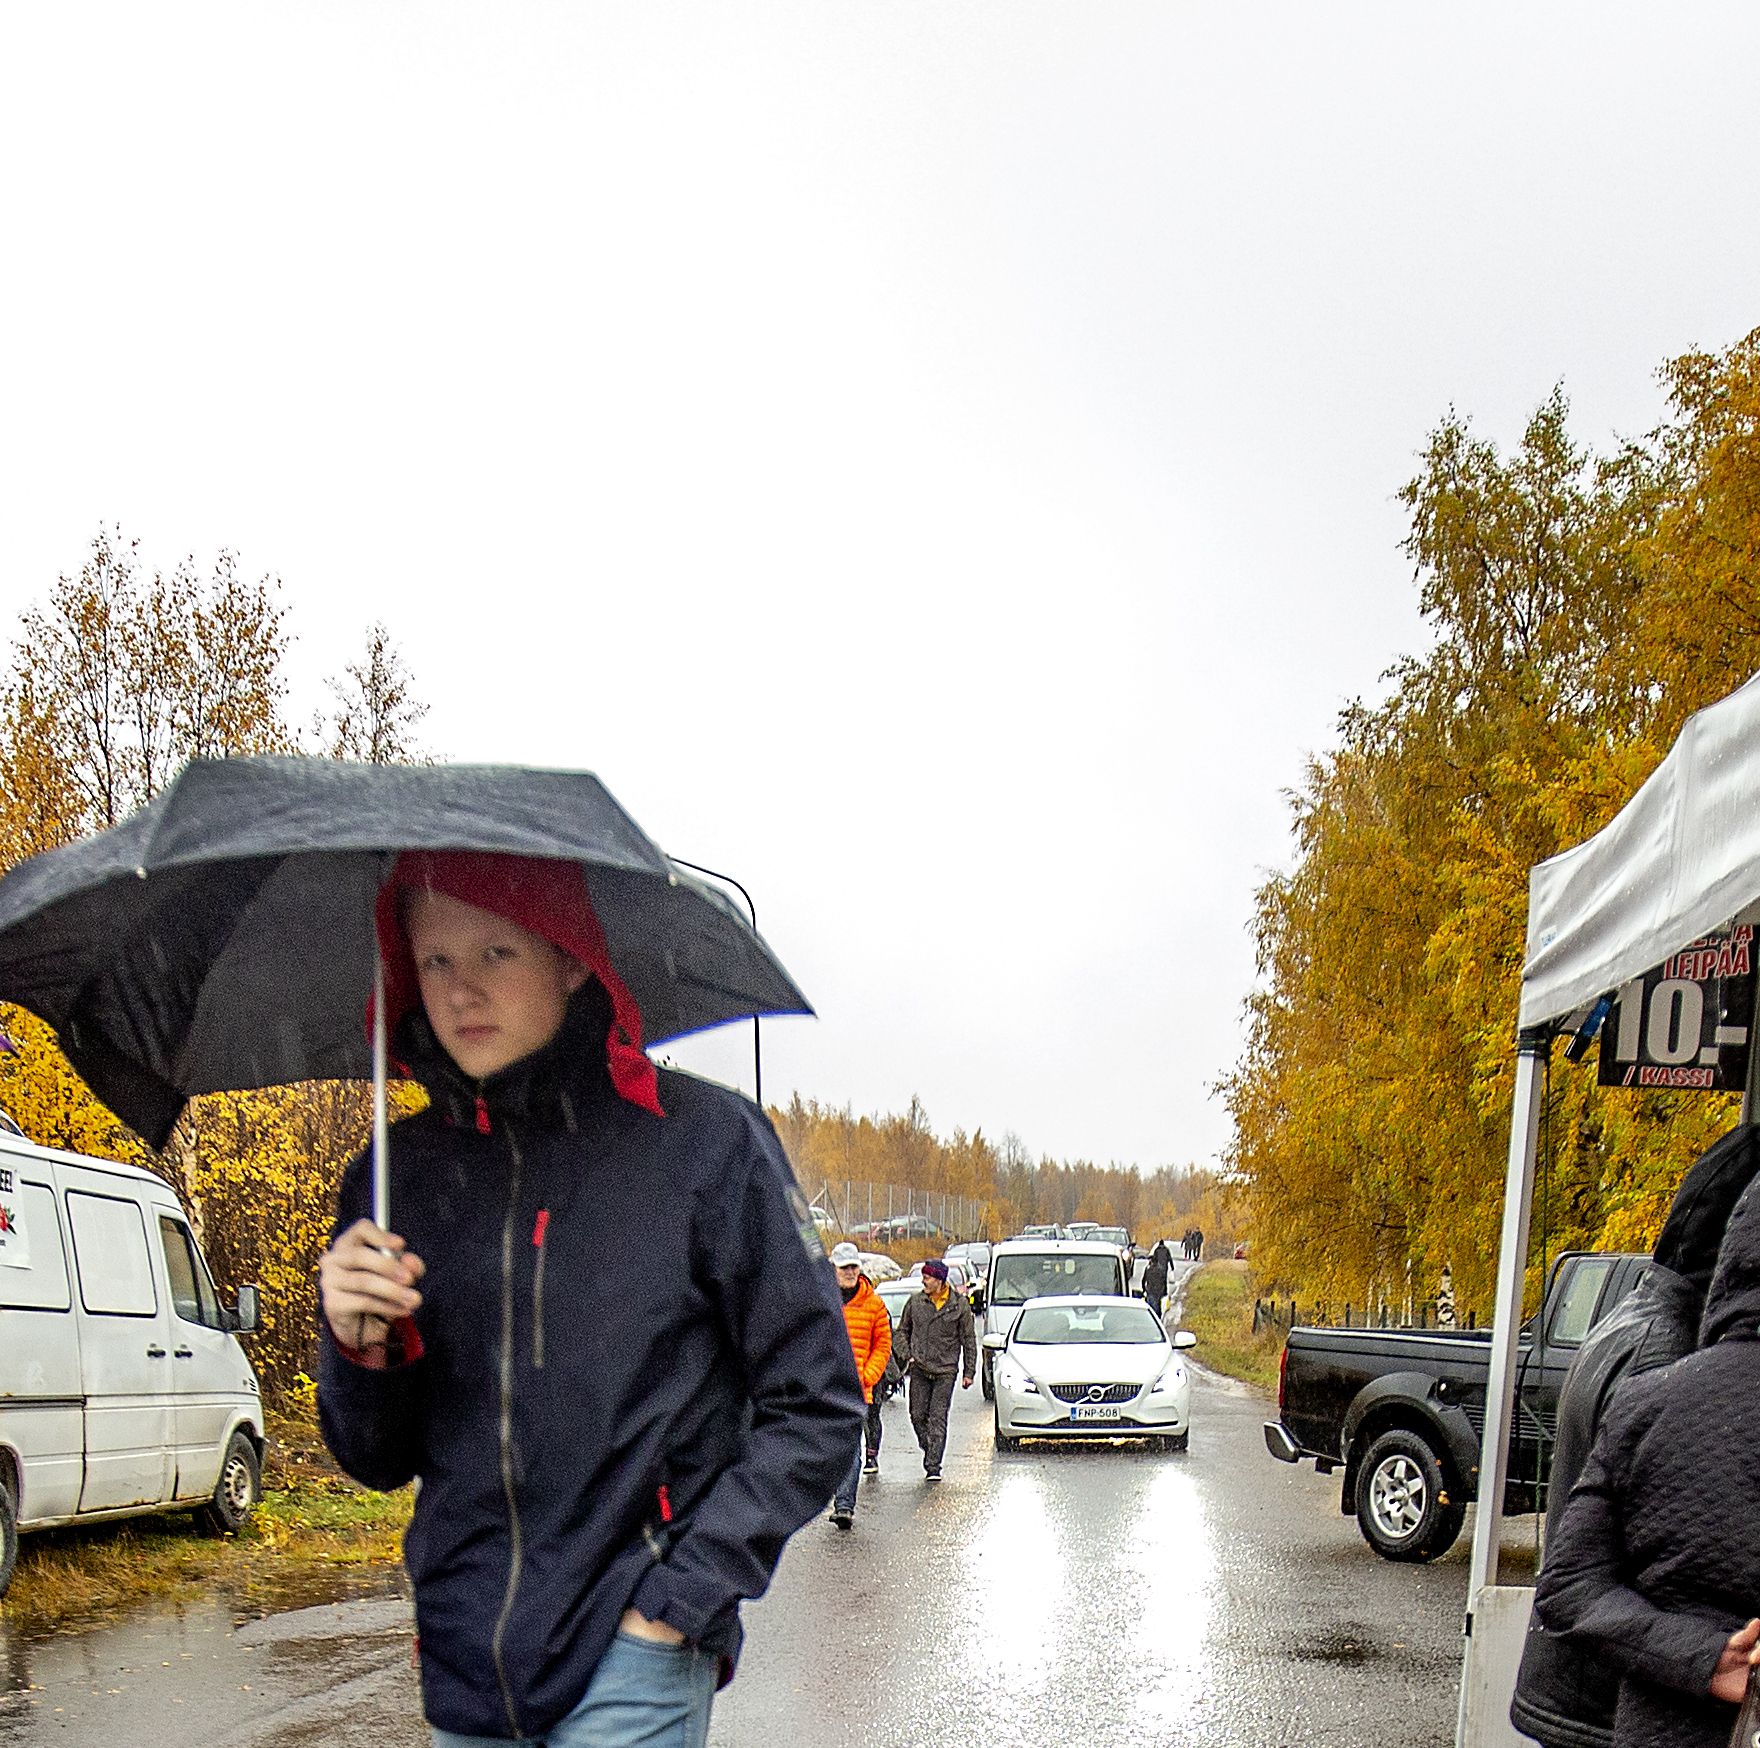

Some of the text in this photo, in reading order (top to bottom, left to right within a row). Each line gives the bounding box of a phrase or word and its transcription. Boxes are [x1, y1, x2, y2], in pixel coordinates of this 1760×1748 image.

[1613, 978, 1747, 1064] 10.-
[1641, 1066, 1714, 1087] KASSI
[1078, 1409, 1118, 1418] FNP-508
